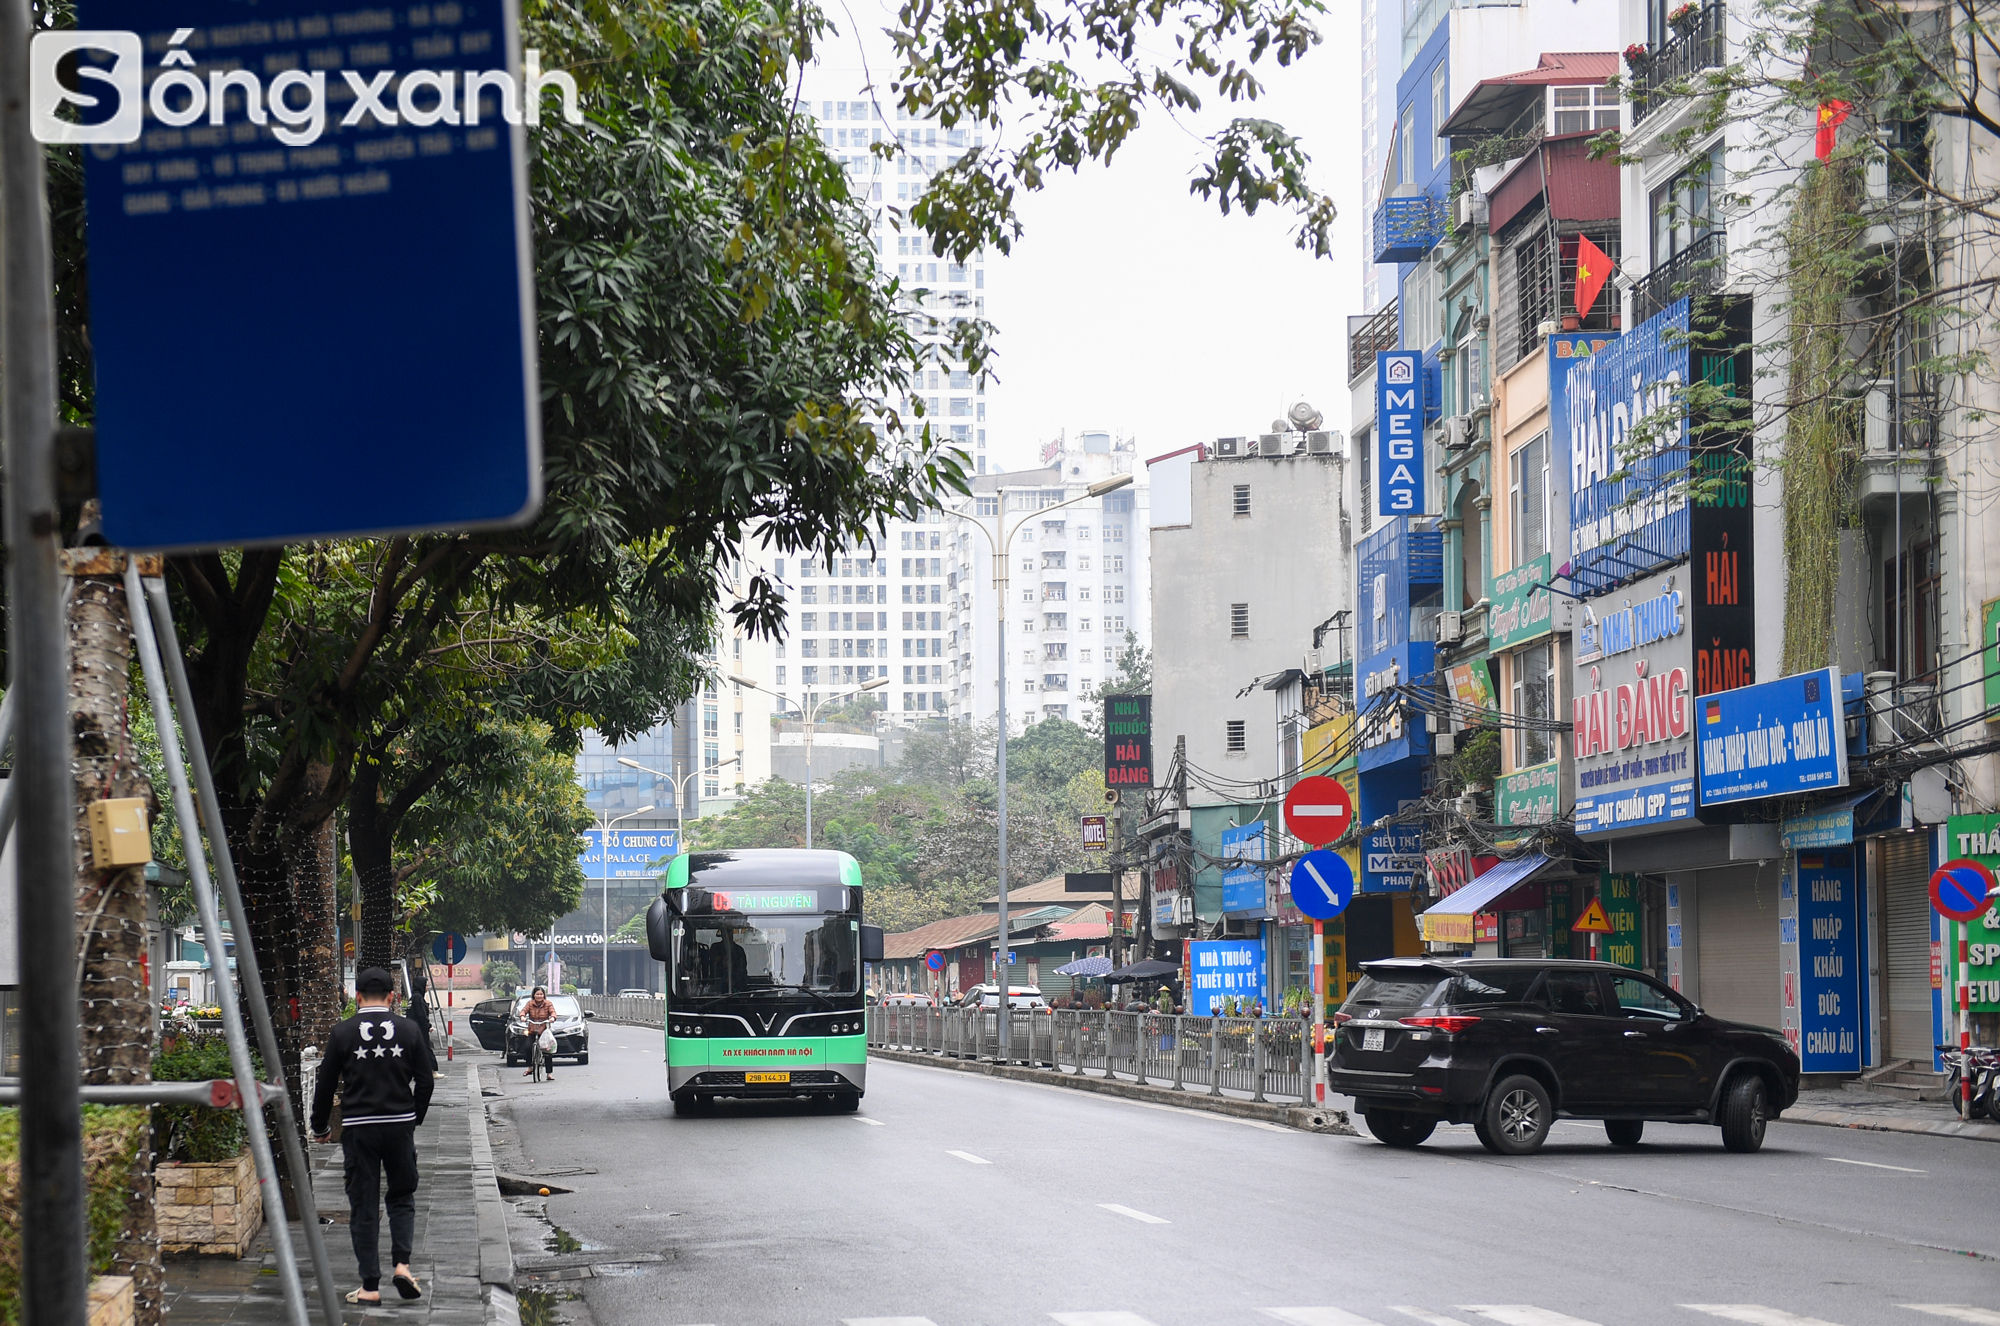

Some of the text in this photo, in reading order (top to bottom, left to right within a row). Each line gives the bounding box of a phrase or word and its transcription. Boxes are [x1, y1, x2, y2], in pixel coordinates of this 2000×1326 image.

[1385, 389, 1415, 509] MEGA3
[1706, 532, 1738, 605] HẢI
[1602, 576, 1685, 657] NHÀ THUỐC
[1697, 636, 1750, 694] ĐĂNG
[1114, 699, 1140, 715] NHÀ
[1573, 658, 1690, 760] HẢI ĐĂNG
[1108, 717, 1148, 735] THUỐC
[1115, 739, 1140, 761] HẢI
[1703, 731, 1725, 776] HÀNG
[1725, 725, 1746, 779] NHẬP
[1746, 713, 1769, 769] KHẨU
[1769, 717, 1787, 765] ĐỨC
[1792, 712, 1816, 761] CHÂU
[1816, 709, 1830, 757] ÂU
[1108, 764, 1149, 784] ĐĂNG
[1598, 802, 1615, 828] ĐẠT
[1616, 789, 1646, 822] CHUẨN
[1647, 793, 1666, 818] GPP
[622, 836, 657, 848] CHUNG
[660, 834, 674, 848] CƯ
[1084, 824, 1105, 842] HOTEL
[736, 893, 757, 908] TÀI
[761, 892, 812, 909] NGUYÊN
[1811, 876, 1842, 901] HÀNG
[554, 935, 583, 946] GẠCH
[1812, 913, 1842, 945] NHẬP
[1200, 946, 1252, 967] NHÀ THUỐC
[1609, 941, 1634, 964] THỜI
[1814, 947, 1843, 977] KHẨU
[1196, 968, 1222, 989] THIẾT
[1225, 973, 1235, 990] BỊ
[1237, 972, 1243, 988] Y
[1246, 967, 1257, 987] TẾ
[1818, 990, 1840, 1016] ĐỨC
[743, 1047, 767, 1056] KHÁCH
[768, 1048, 785, 1056] NAM
[787, 1047, 797, 1056] HÀ
[798, 1047, 813, 1057] NỘI
[1807, 1027, 1854, 1054] CHÂU ÂU
